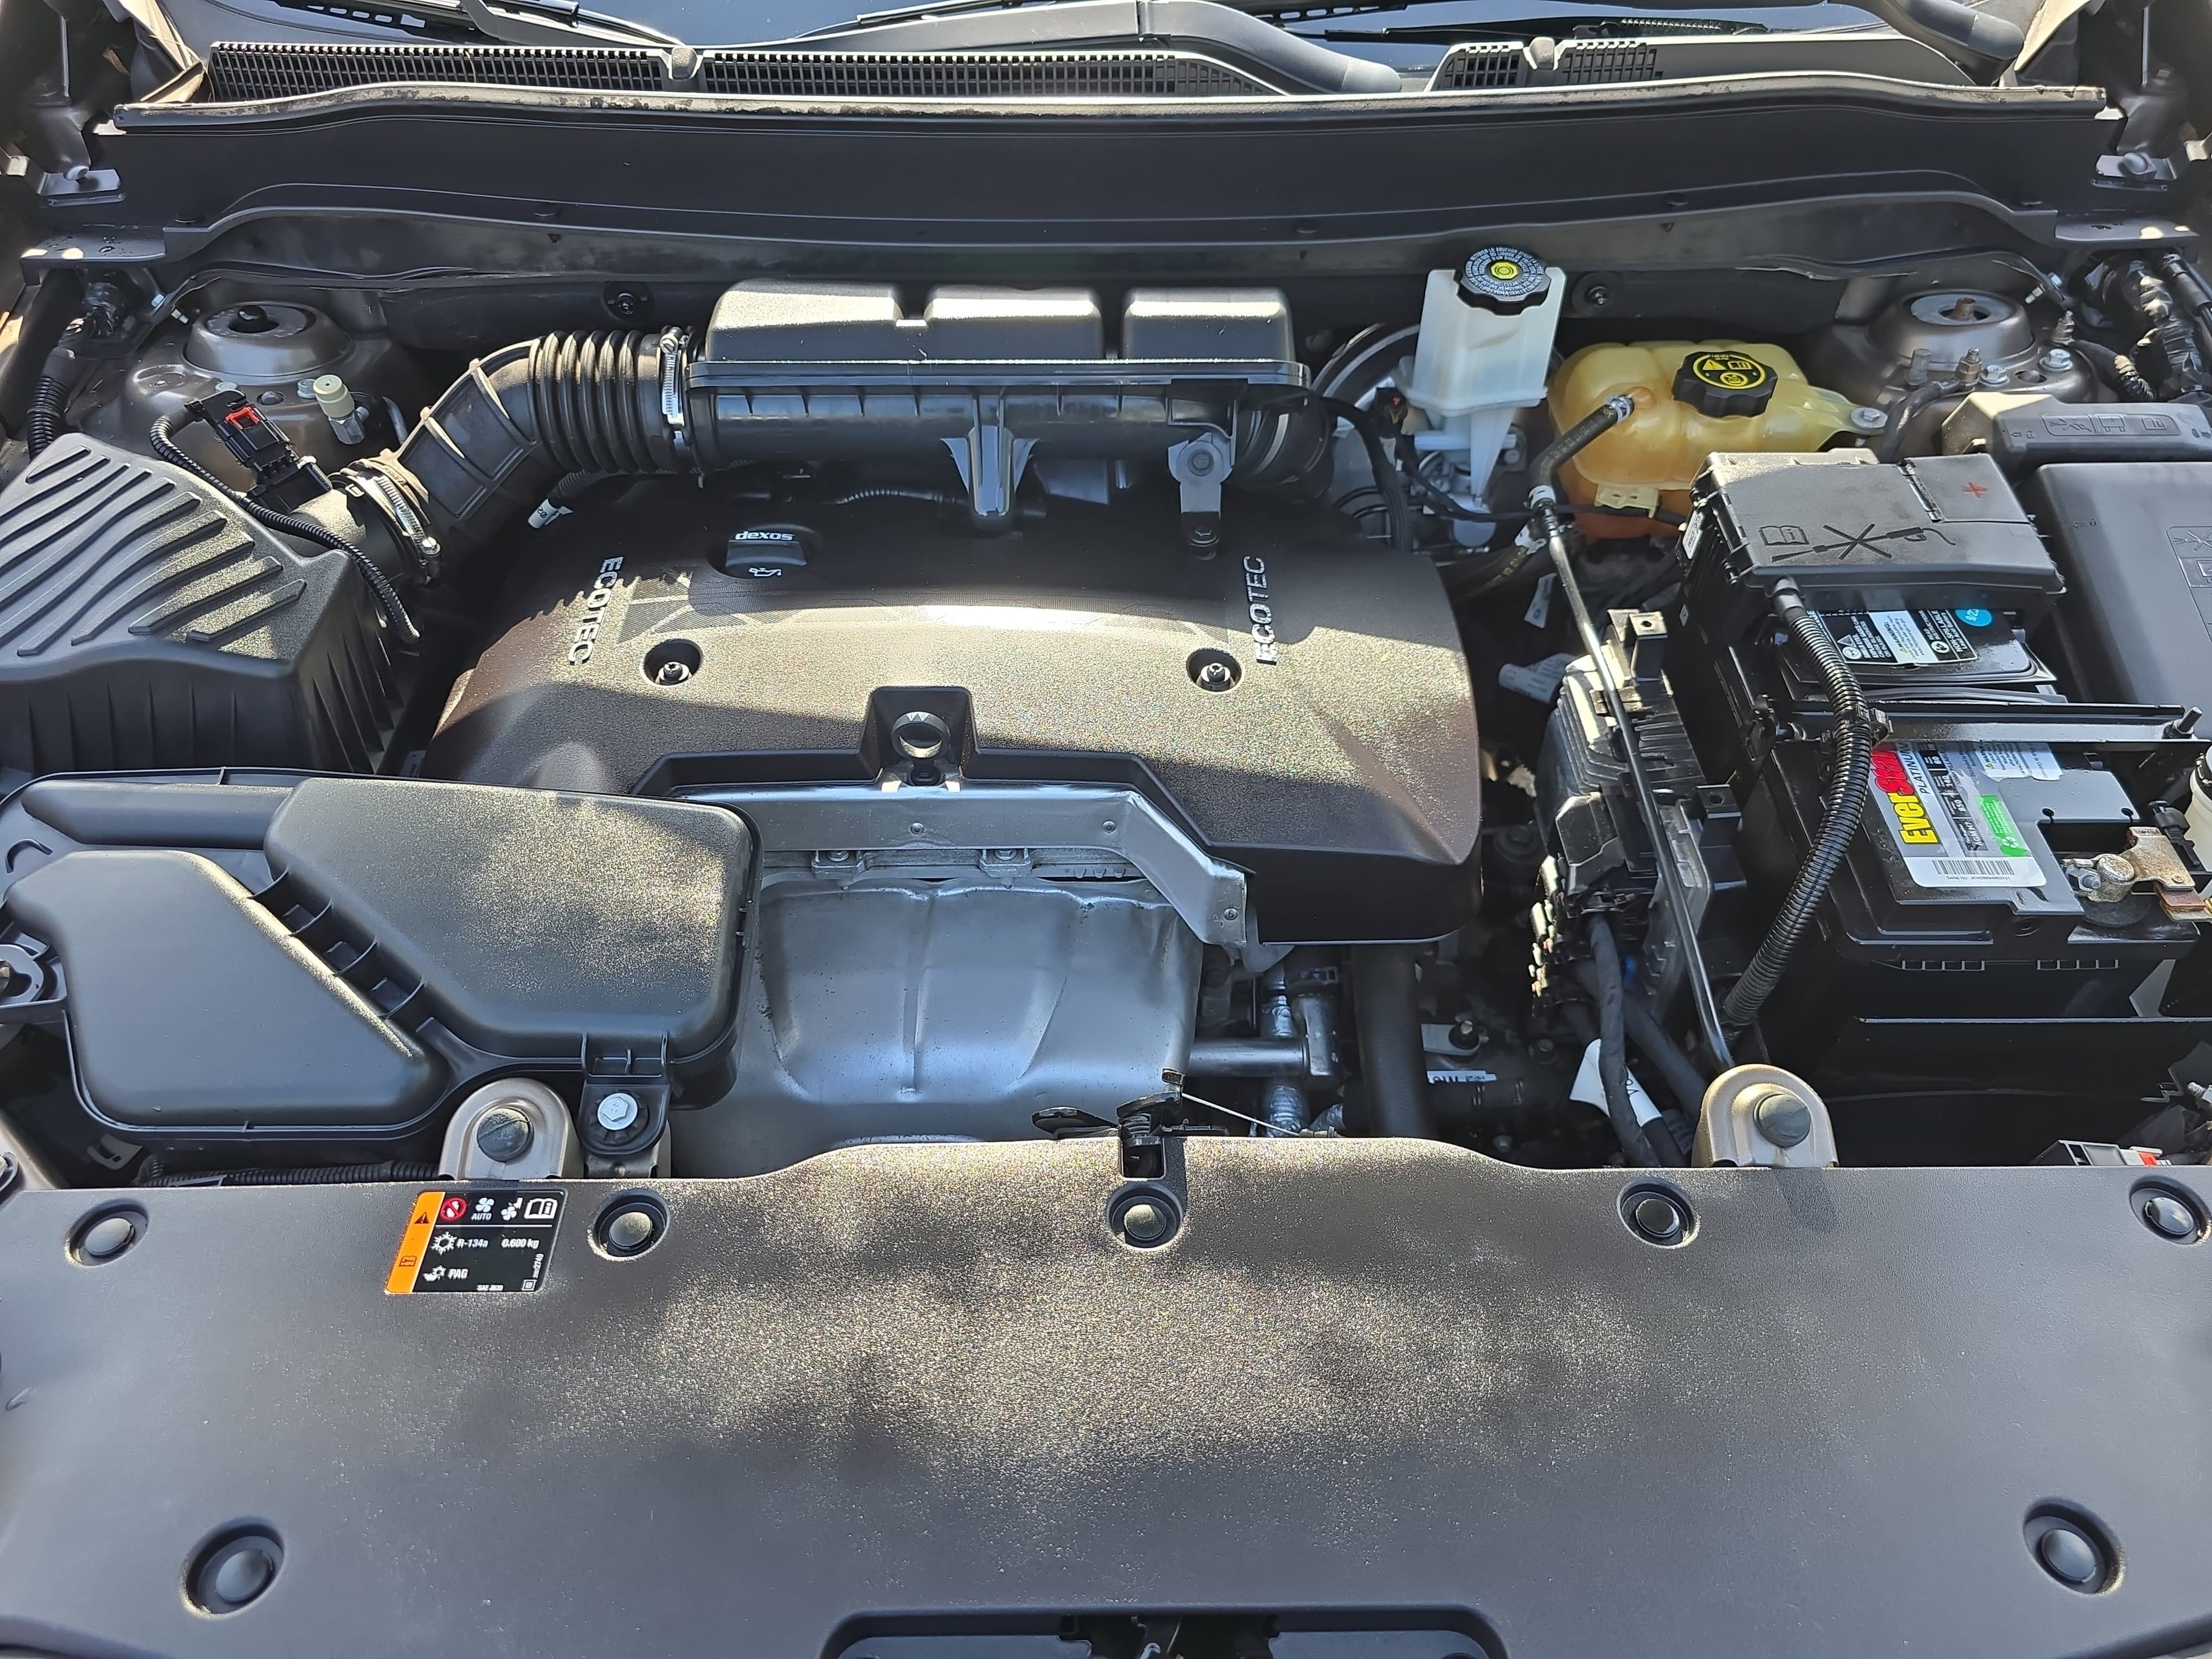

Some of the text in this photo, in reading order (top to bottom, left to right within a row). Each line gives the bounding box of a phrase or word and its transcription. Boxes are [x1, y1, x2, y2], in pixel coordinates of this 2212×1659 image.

[735, 531, 795, 541] dexos
[569, 556, 623, 664] ECOTEC
[1243, 556, 1278, 664] ECOTEC
[1881, 622, 1904, 647] WARNING:
[1922, 628, 1934, 640] READ
[1930, 610, 1961, 651] NON-SPILLABLE
[1948, 628, 1960, 637] Acid
[1954, 638, 1968, 648] Lead
[1901, 750, 1928, 794] PLATINU
[1953, 799, 1966, 811] 850
[1969, 831, 1984, 846] AGM
[457, 1238, 539, 1249] R-134a 0.600 kg
[448, 1269, 468, 1279] PAG
